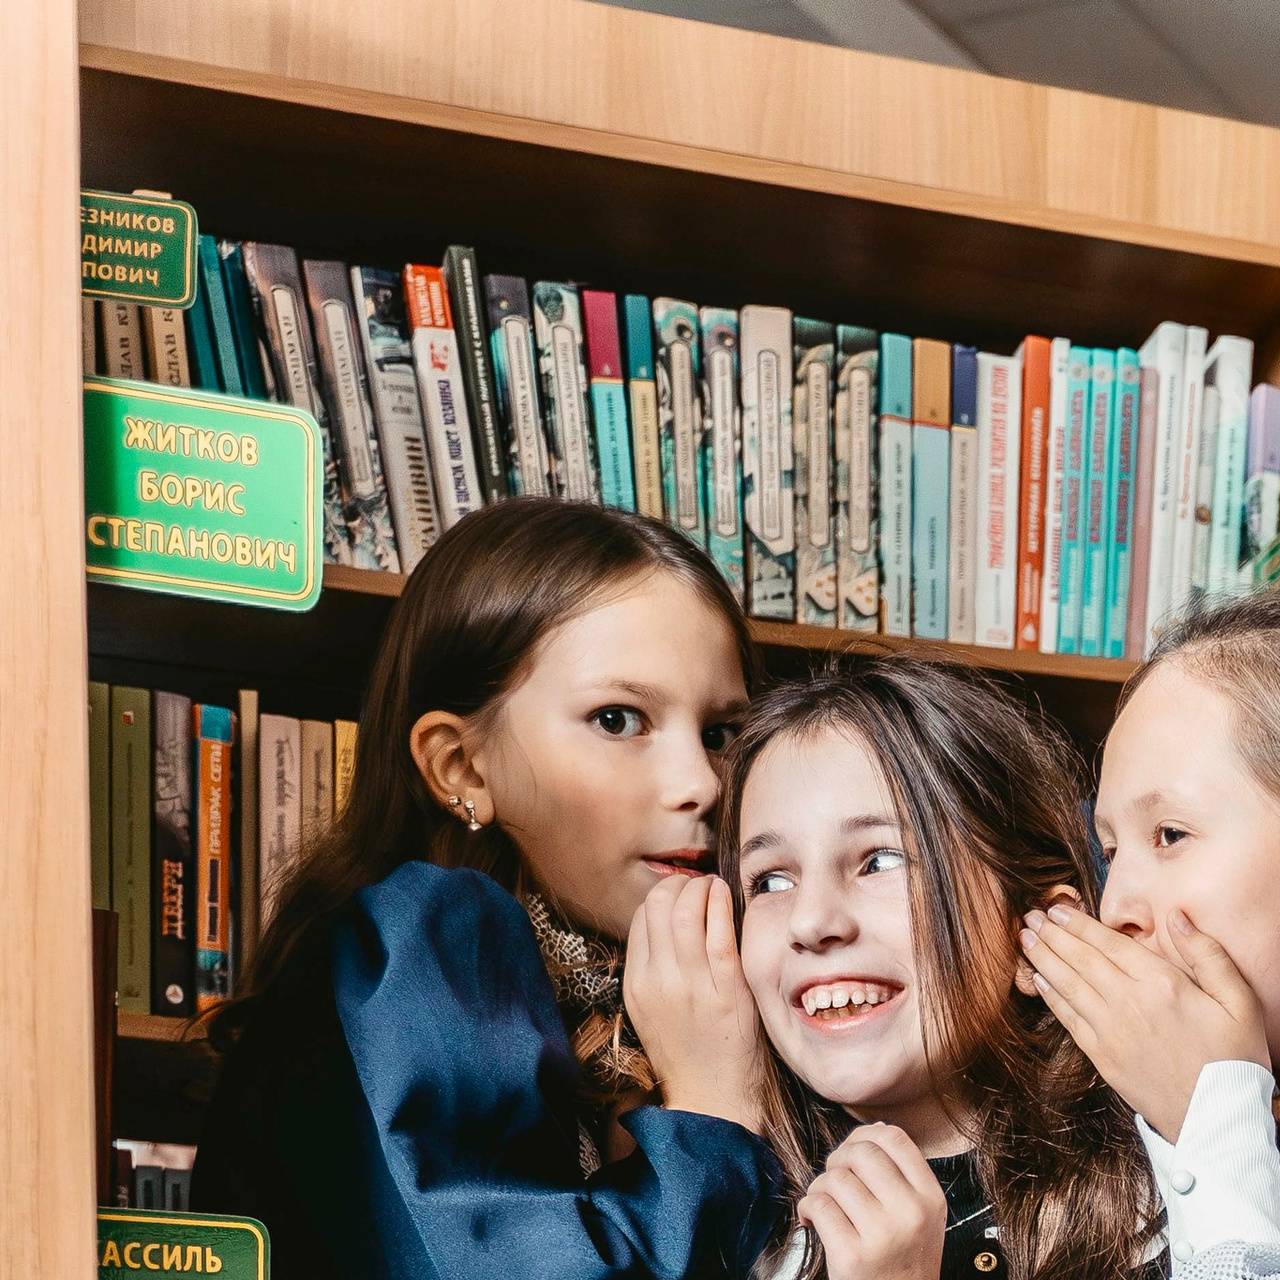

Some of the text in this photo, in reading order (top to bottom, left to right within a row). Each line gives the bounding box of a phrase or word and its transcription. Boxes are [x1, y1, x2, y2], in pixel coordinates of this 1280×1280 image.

[82, 233, 163, 260] ДИМИР
[82, 261, 160, 287] ПОВИЧ
[125, 416, 260, 467] ЖИТКОВ
[139, 470, 246, 516] БОРИС
[87, 515, 297, 574] СТЕПАНОВИЧ
[98, 1239, 223, 1274] АССИЛЬ
